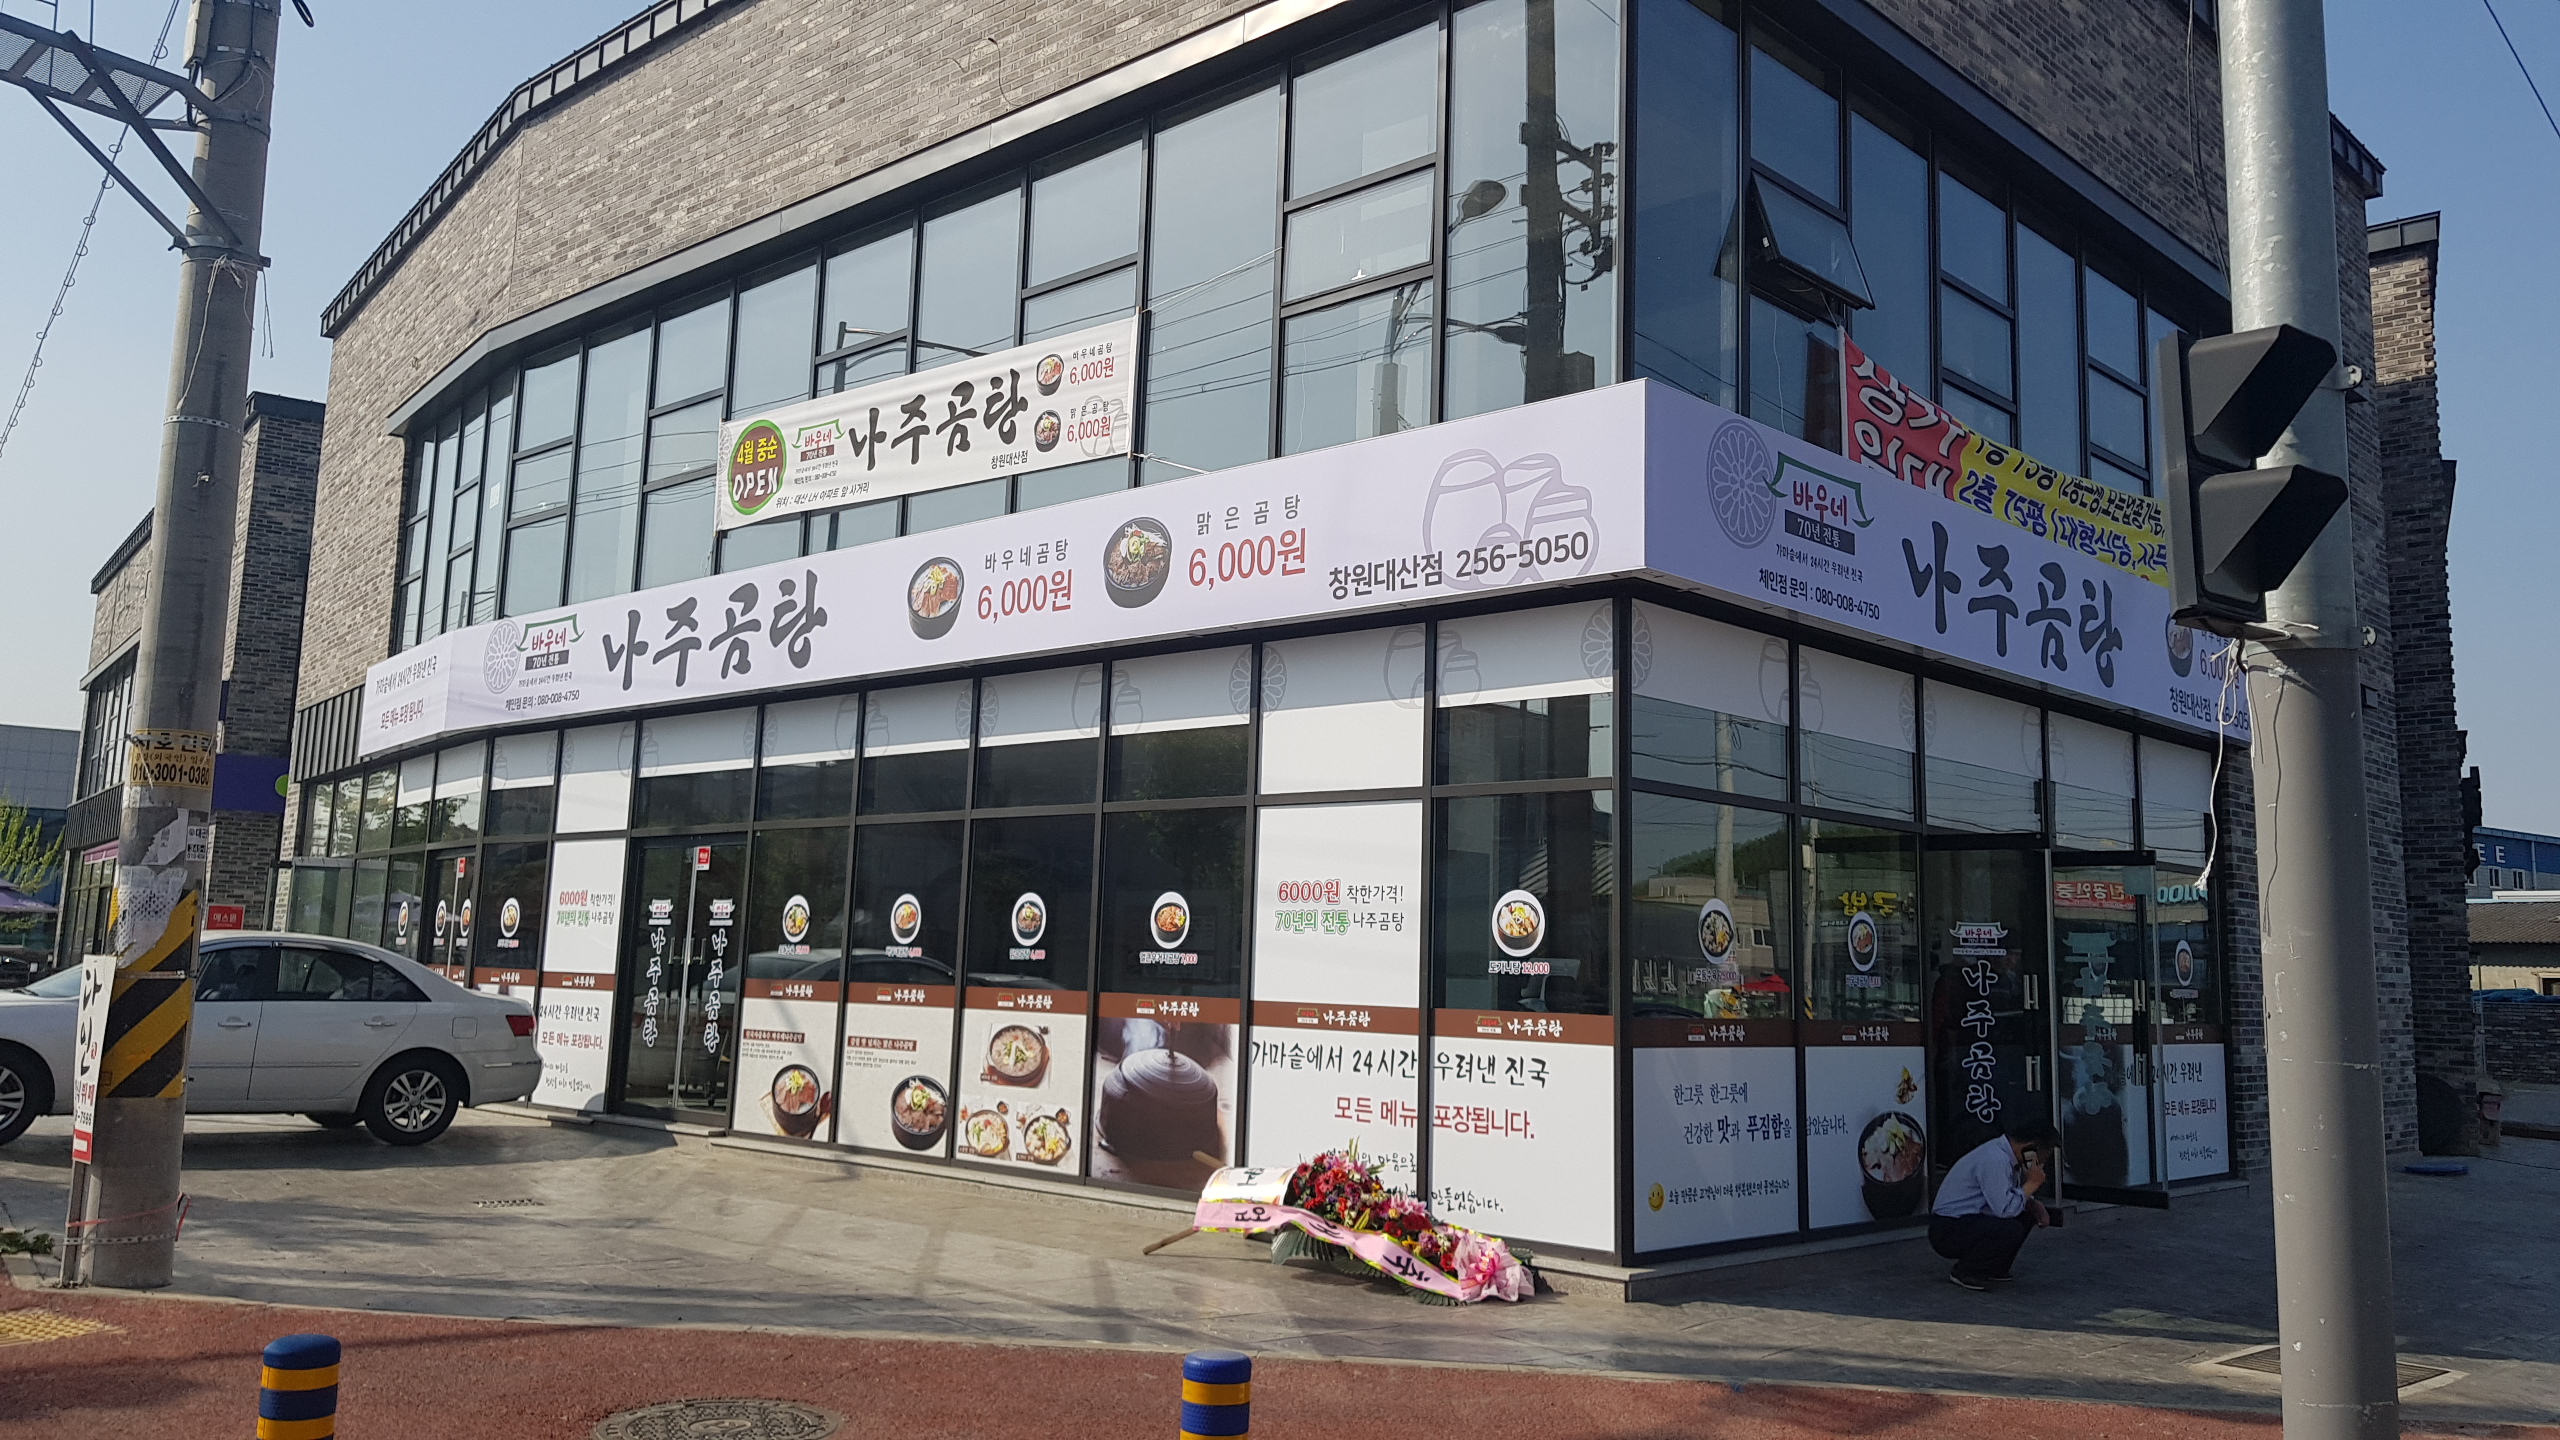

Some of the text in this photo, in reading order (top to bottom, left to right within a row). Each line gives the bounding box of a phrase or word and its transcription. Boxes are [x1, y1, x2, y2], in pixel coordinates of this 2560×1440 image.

[1070, 356, 1115, 385] 6,000원
[849, 368, 1029, 471] 나주곰탕
[1067, 415, 1111, 443] 6,000원
[737, 434, 778, 464] 4월 중순
[805, 429, 832, 450] 바우네
[990, 449, 1029, 472] 창원대산점
[733, 466, 779, 502] OPEN
[849, 481, 870, 495] 사거리
[1792, 480, 1848, 526] 바우네
[1958, 469, 1998, 515] 2층
[2004, 488, 2048, 538] 75평
[1797, 518, 1841, 549] 70년 전통
[984, 538, 1070, 573] 바우네곰탕
[1188, 527, 1306, 591] 6,000원
[1328, 531, 1590, 601] 창원대산점 256-5050
[977, 567, 1073, 624] 6,000원
[1759, 567, 1788, 595] 체인점
[1815, 586, 1880, 620] 080-008-4750
[1901, 520, 2123, 688] 나주곰탕
[532, 627, 567, 655] 바우네
[602, 569, 828, 692] 나주곰탕
[532, 655, 547, 669] 70년
[537, 689, 580, 706] 080-008-4750
[559, 890, 588, 907] 6000원
[1278, 880, 1404, 904] 6000원 착한가격!
[1276, 910, 1404, 934] 70년의 전통 나주곰탕
[541, 1031, 555, 1046] 모든
[1252, 1040, 1550, 1088] 가마솥에서 24시간 우려낸 진국
[1673, 1081, 1748, 1105] 한그릇 한그릇에
[1334, 1096, 1536, 1140] 모든 메뉴 포장됩니다.
[1684, 1122, 1713, 1144] 건강한
[1717, 1115, 1741, 1145] 맛과
[1746, 1113, 1792, 1142] 푸짐함을
